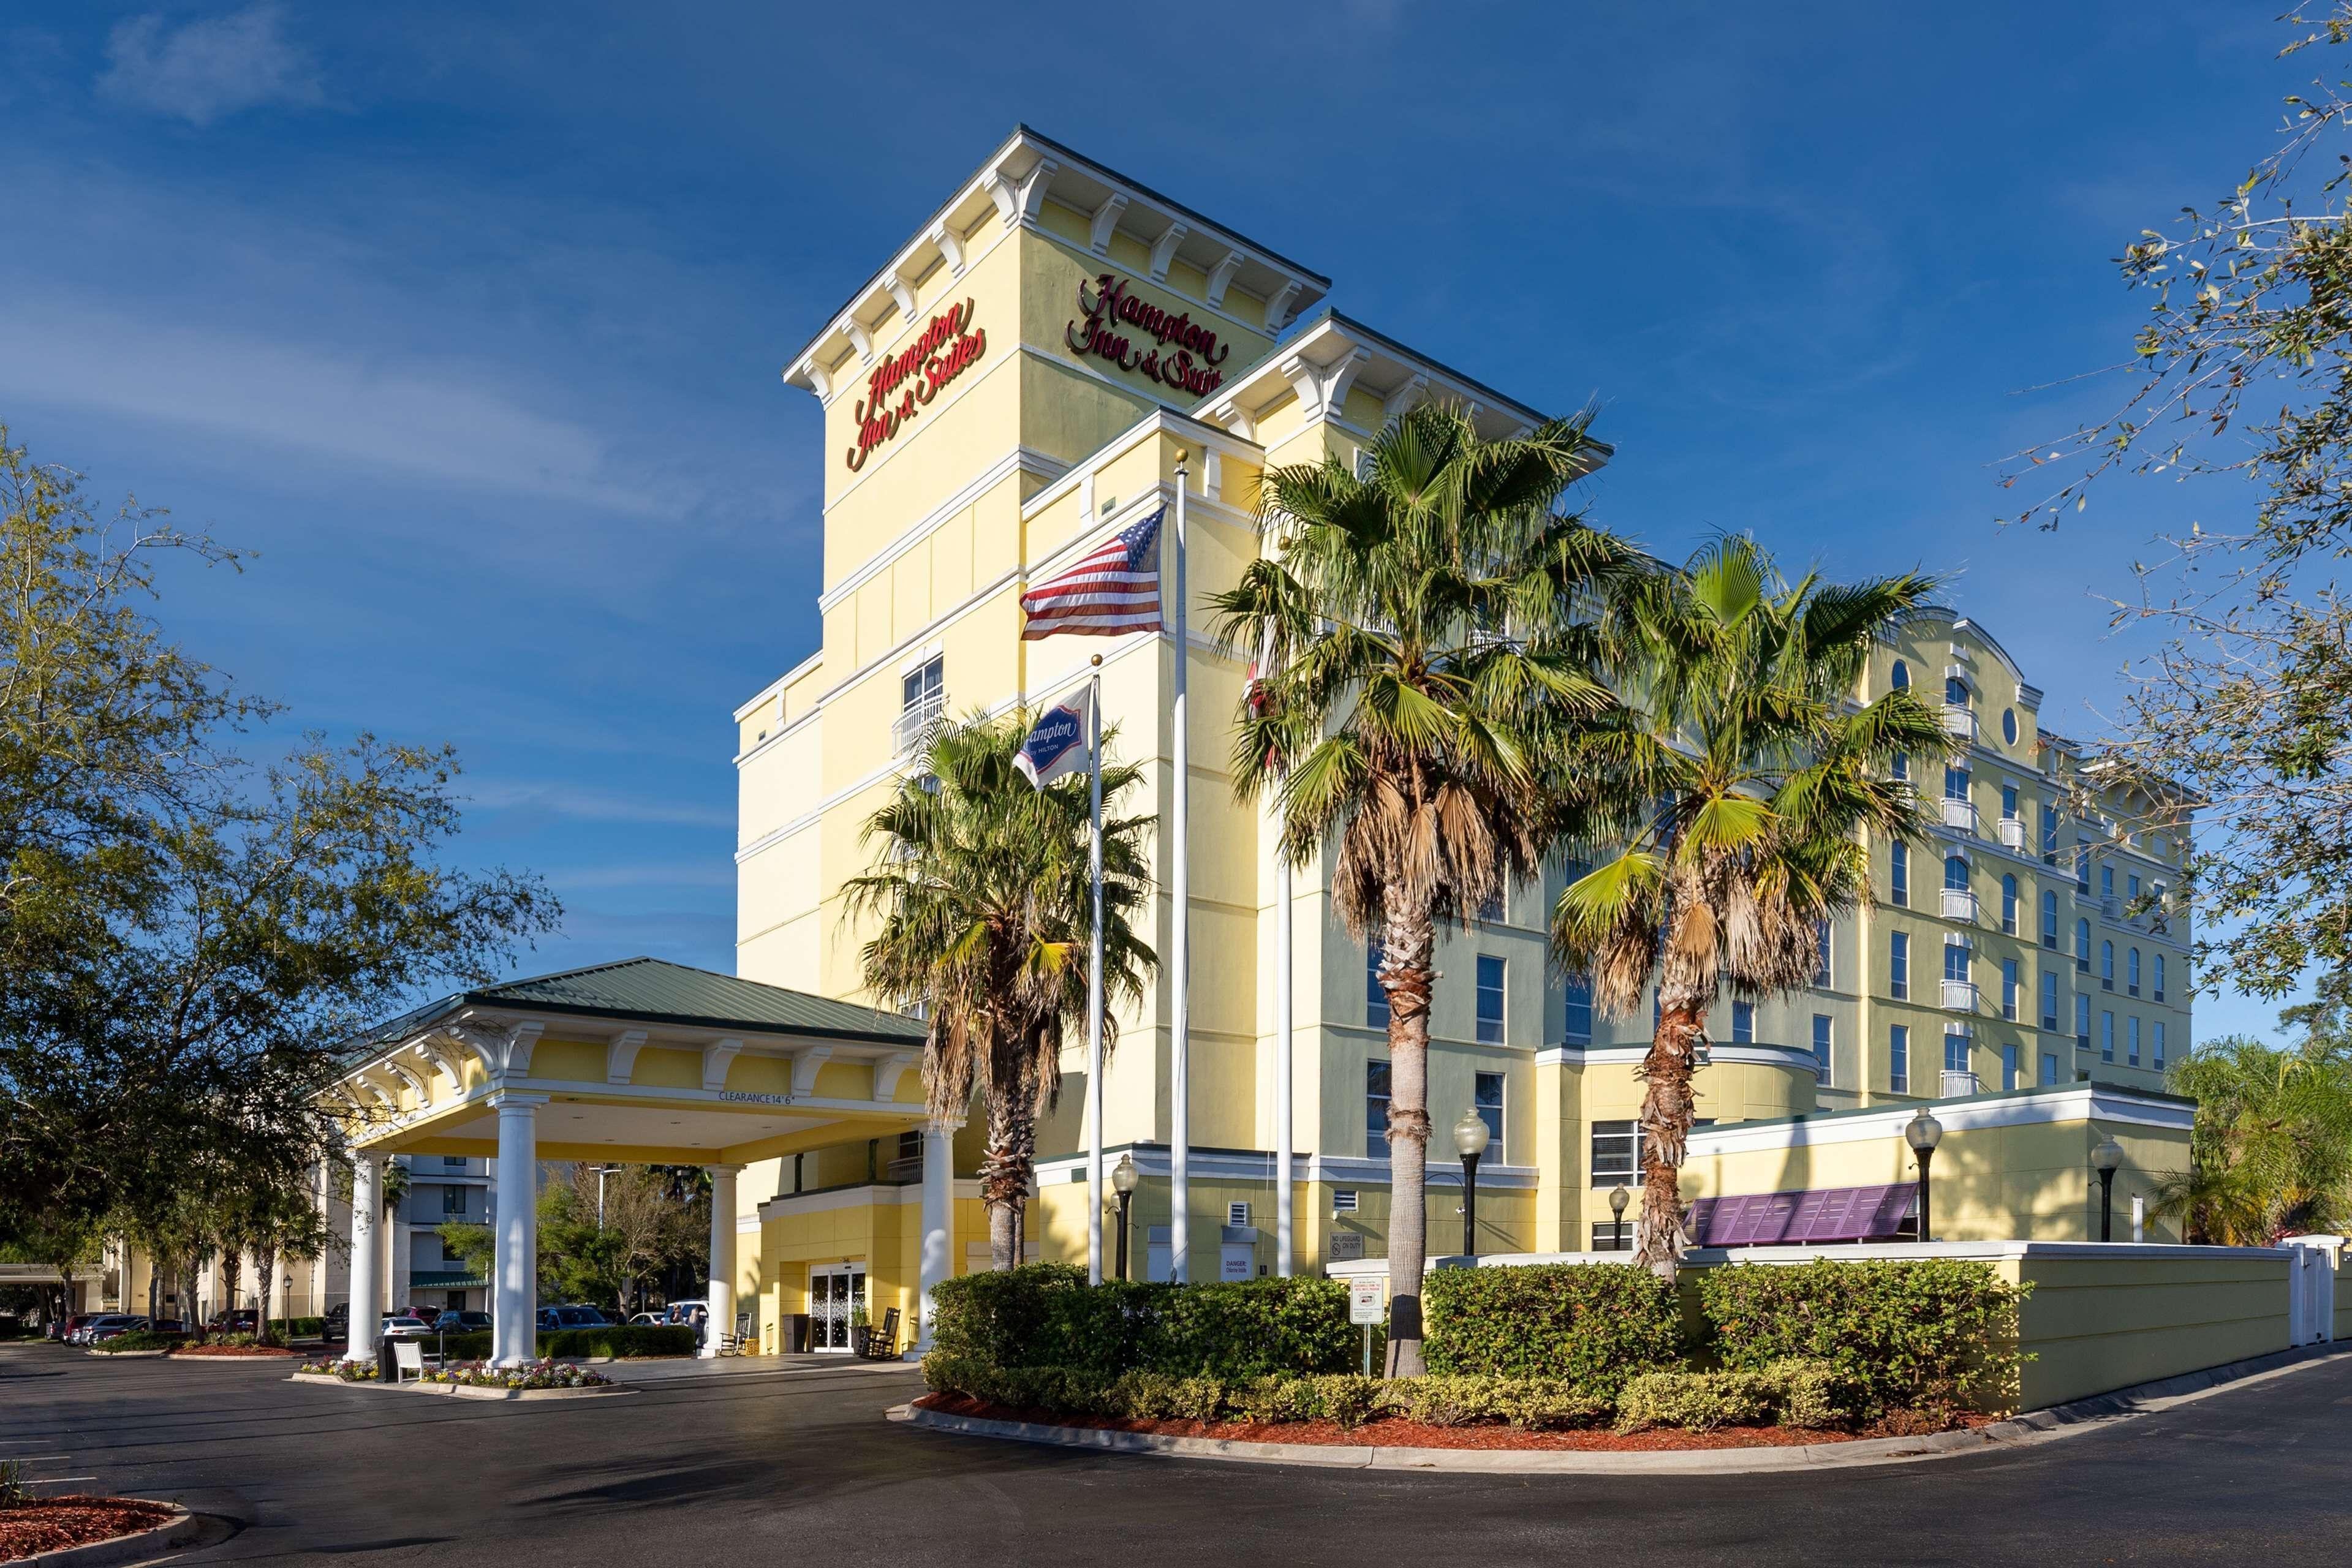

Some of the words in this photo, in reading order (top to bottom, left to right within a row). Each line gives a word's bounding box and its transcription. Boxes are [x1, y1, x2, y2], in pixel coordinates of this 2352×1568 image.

[1064, 317, 1142, 372] Inn
[1141, 349, 1163, 383] &
[1162, 349, 1223, 398] Suit
[1078, 274, 1229, 366] Hampton
[847, 407, 902, 472] Inn
[899, 390, 918, 421] &
[916, 328, 986, 405] Suites
[855, 297, 975, 426] Hampton
[1024, 722, 1076, 750] ampton
[1038, 744, 1059, 753] HILTON
[719, 1091, 770, 1103] CLEARANCE
